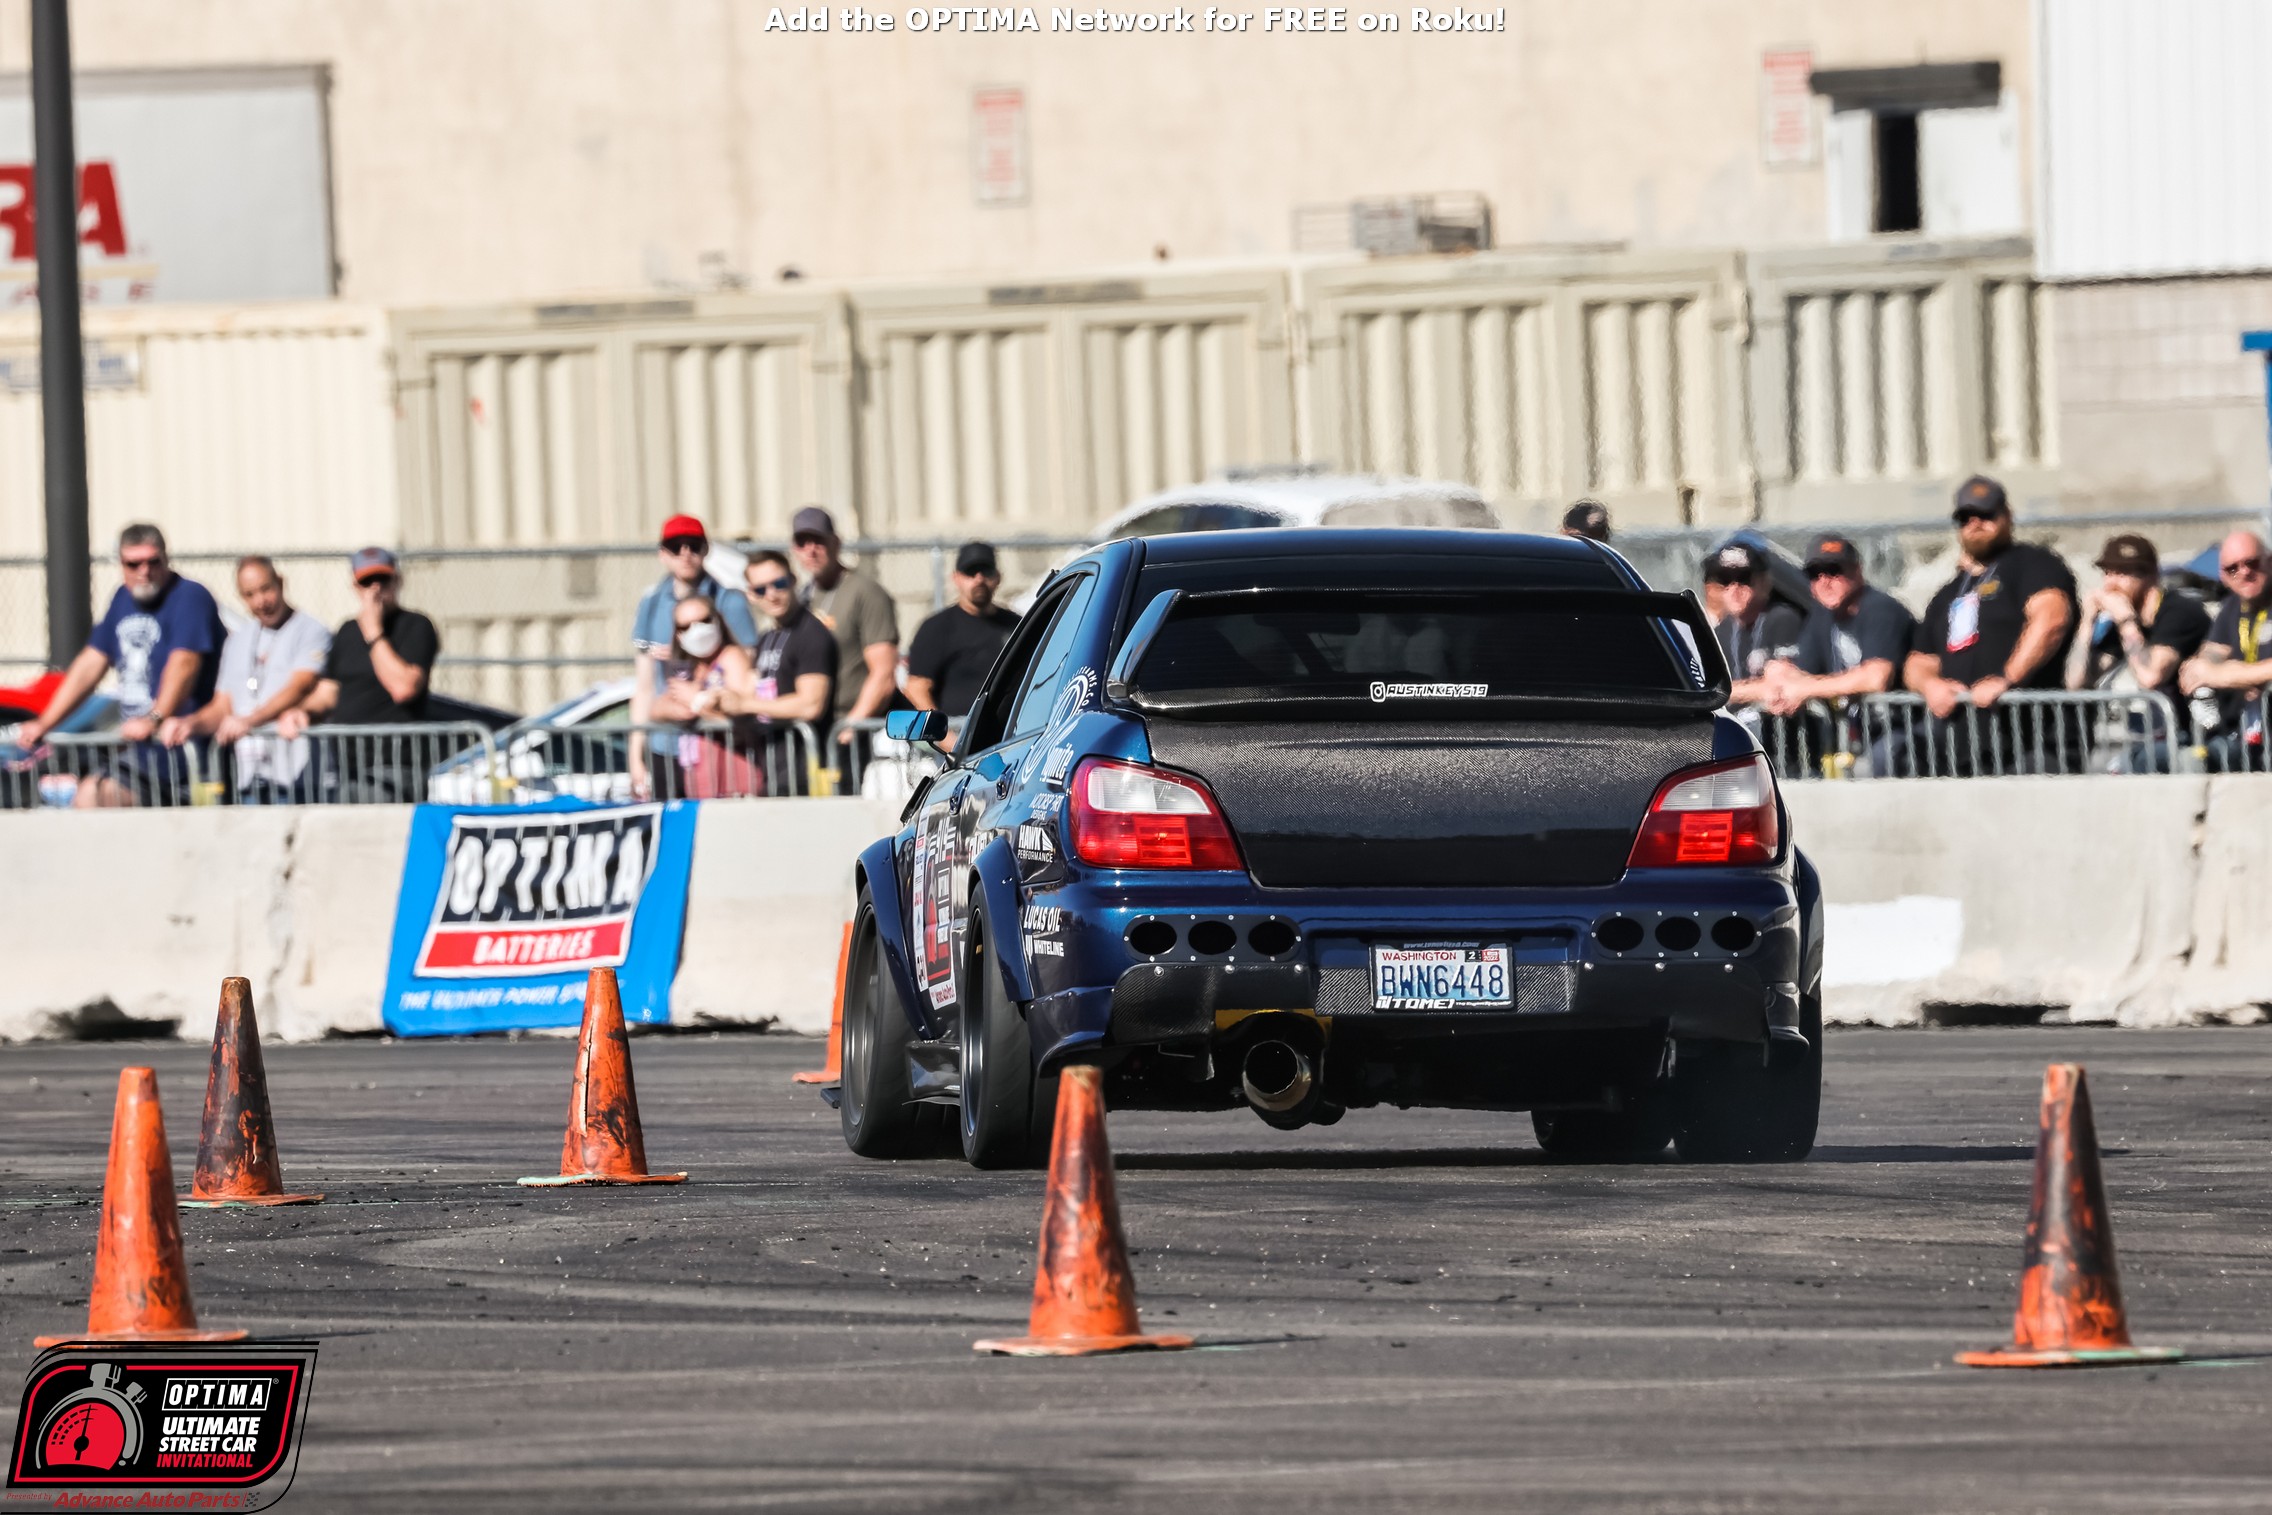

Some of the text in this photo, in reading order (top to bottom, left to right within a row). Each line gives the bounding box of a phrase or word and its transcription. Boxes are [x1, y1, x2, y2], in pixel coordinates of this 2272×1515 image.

[1018, 825, 1042, 851] HAWK
[1017, 849, 1053, 863] PERFORMANCE
[449, 826, 644, 915] OPTIMA
[1023, 905, 1061, 932] LUCAS OIL
[473, 930, 596, 964] BATTERIES
[1382, 952, 1457, 961] WASHINGTON
[1381, 965, 1503, 998] BWN6448
[1392, 998, 1456, 1009] TOMEI
